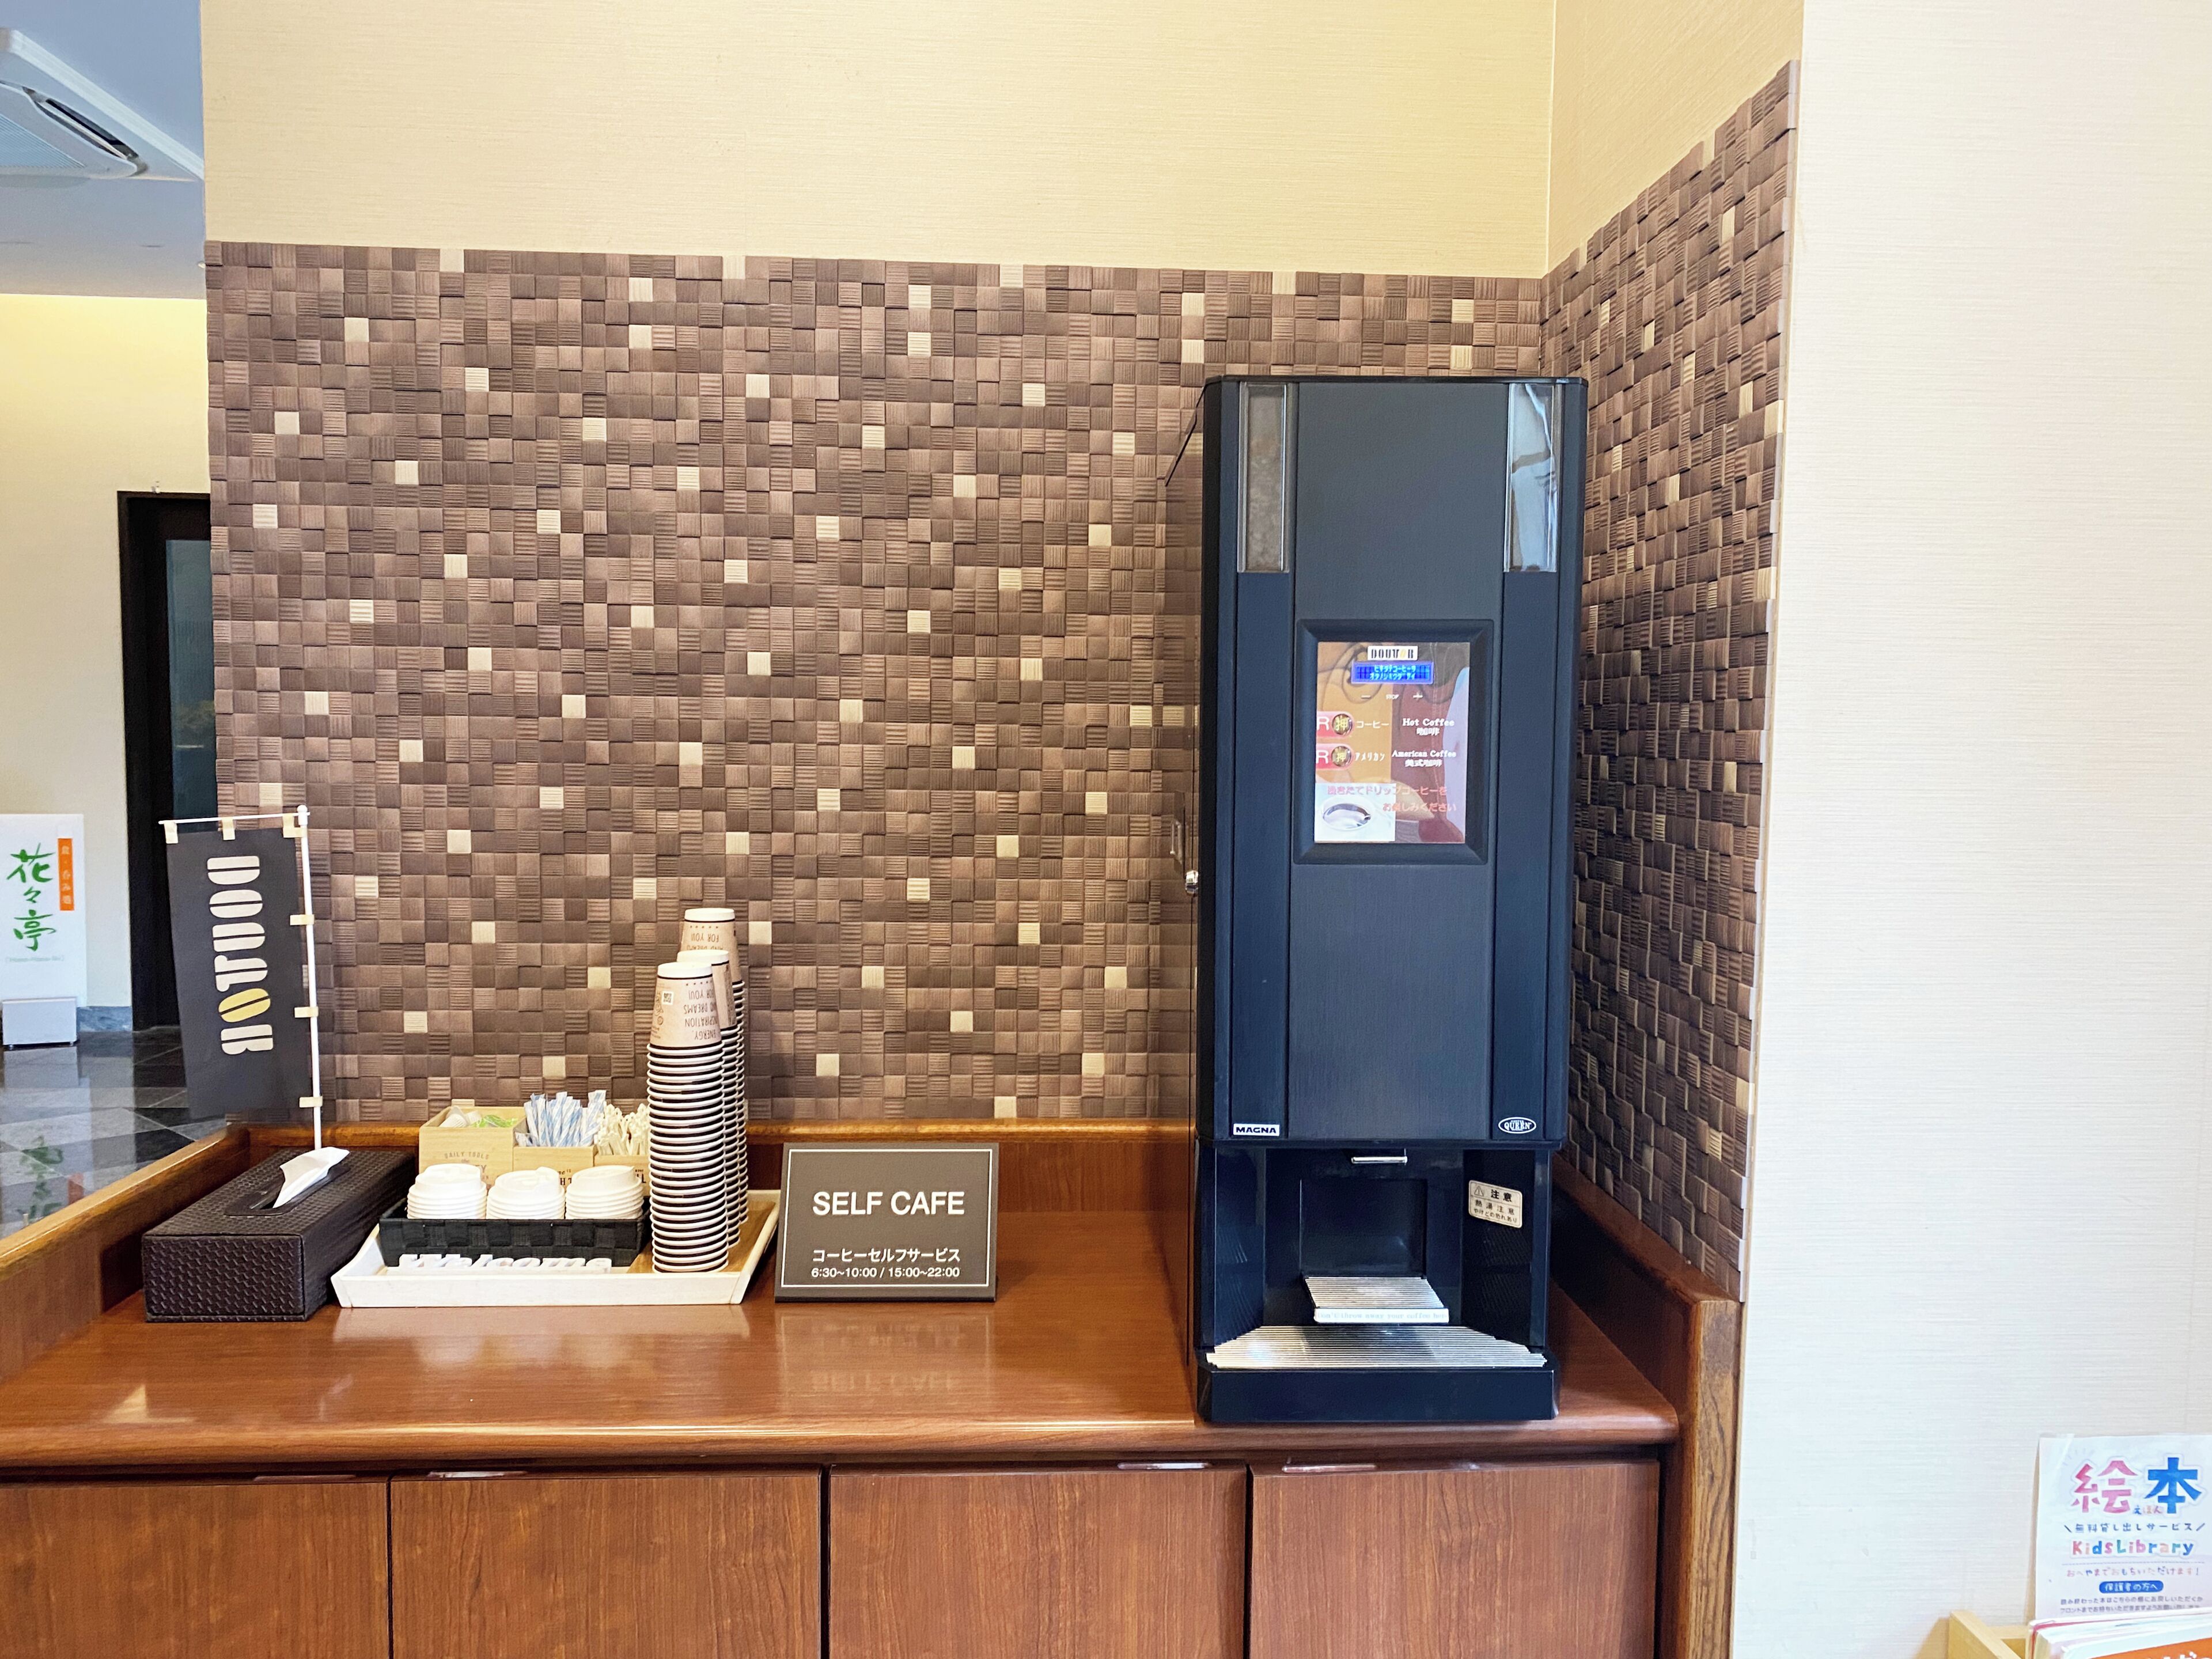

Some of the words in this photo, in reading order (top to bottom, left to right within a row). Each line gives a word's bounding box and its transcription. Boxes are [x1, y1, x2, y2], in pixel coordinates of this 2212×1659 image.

[1372, 649, 1414, 659] DOUTOR
[1356, 720, 1389, 729] コーヒー
[1402, 718, 1419, 726] Hot
[1422, 718, 1455, 726] Coffee
[6, 842, 56, 951] 花々亭
[707, 934, 719, 943] FOR
[207, 855, 274, 1055] DOUTOR
[683, 1003, 708, 1014] DREAMS
[1504, 1122, 1531, 1131] QUEEN
[1491, 1189, 1512, 1202] 注意
[812, 1191, 883, 1215] SELF
[890, 1191, 965, 1215] CAFE
[812, 1248, 961, 1263] コーヒーセルフサービス
[2071, 1457, 2202, 1514] 絵本
[2133, 1505, 2163, 1514] えほん
[2104, 1582, 2158, 1592] 保護者の方へ
